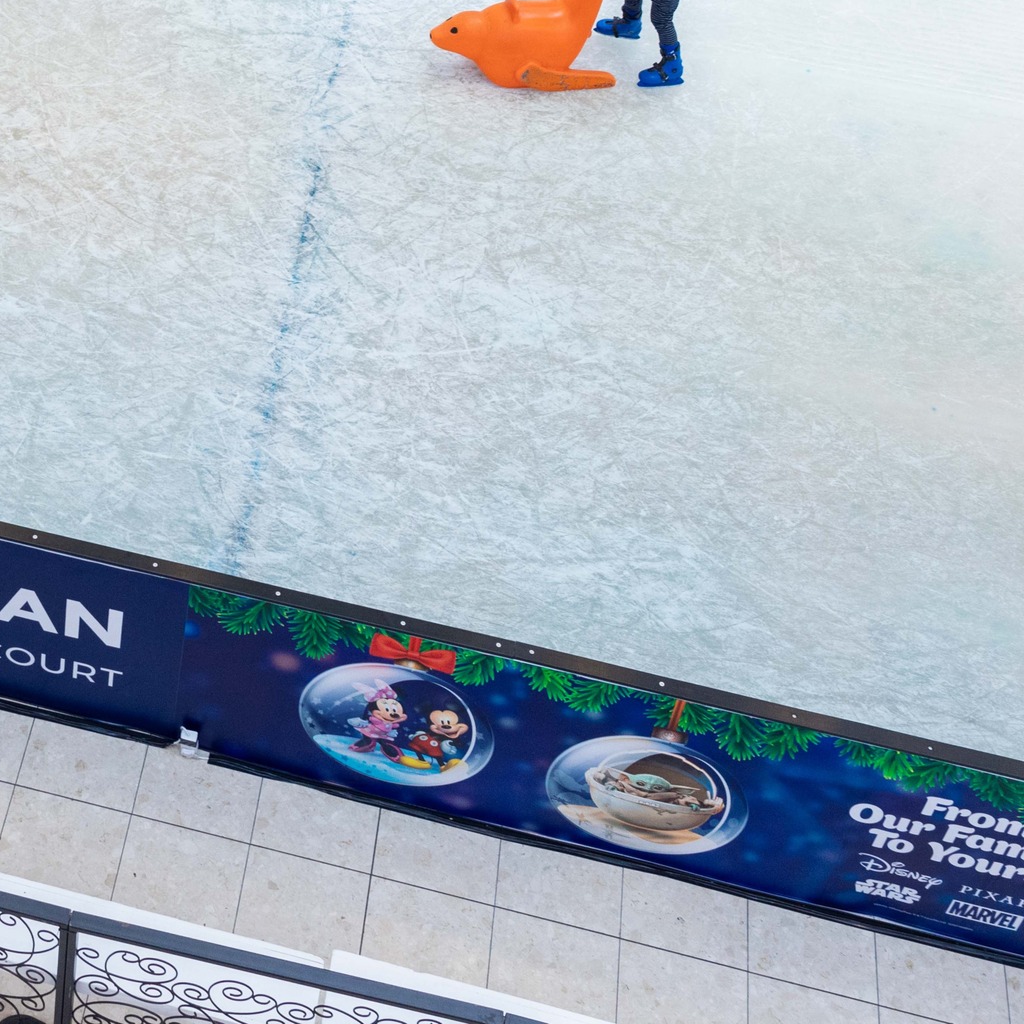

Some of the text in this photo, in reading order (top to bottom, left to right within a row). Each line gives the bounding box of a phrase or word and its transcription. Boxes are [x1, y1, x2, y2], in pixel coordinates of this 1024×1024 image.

[848, 802, 936, 836] Our
[920, 795, 1024, 837] From
[868, 827, 1024, 880] To Your
[855, 878, 920, 896] STAR
[855, 884, 922, 905] WARS
[949, 900, 1018, 929] MARVEL
